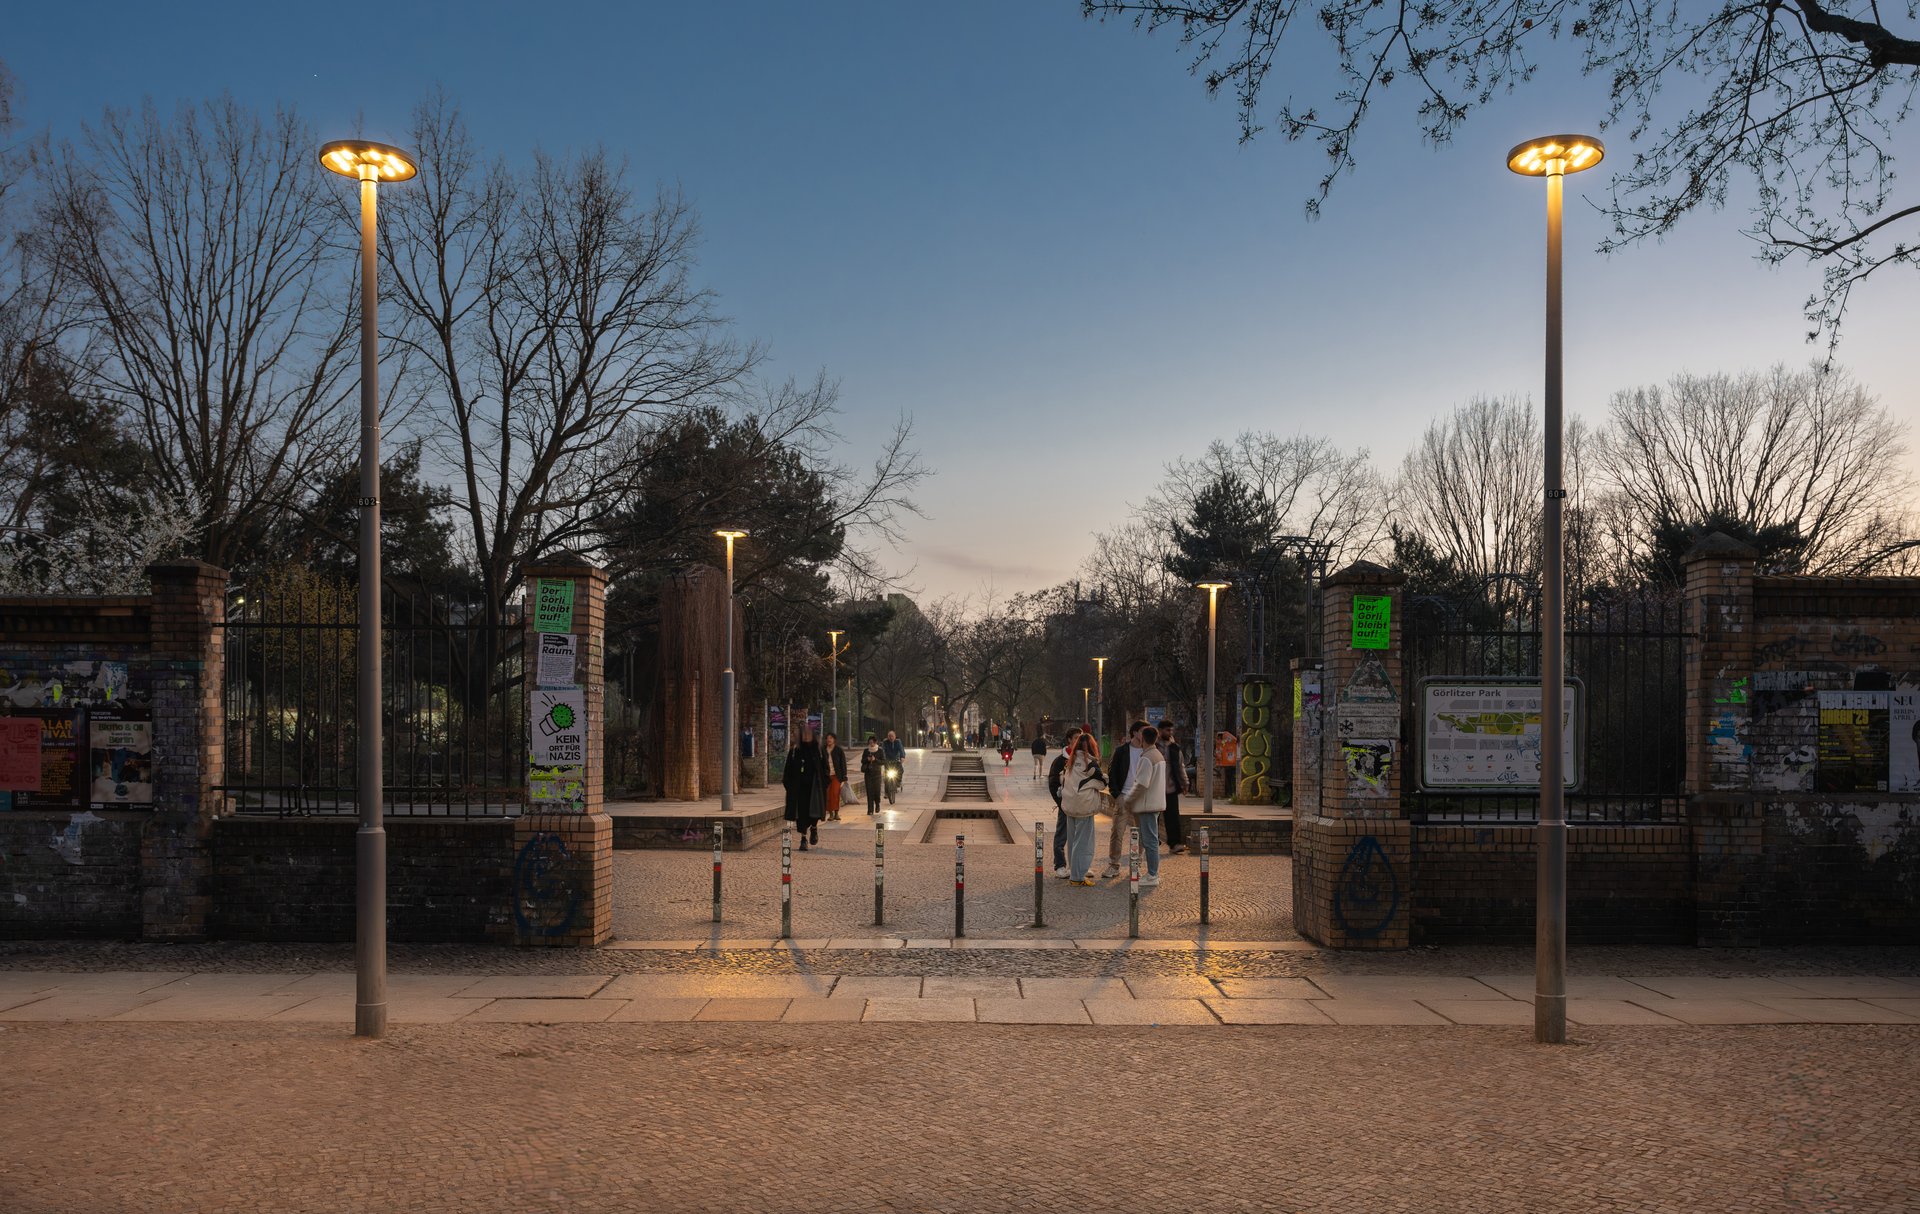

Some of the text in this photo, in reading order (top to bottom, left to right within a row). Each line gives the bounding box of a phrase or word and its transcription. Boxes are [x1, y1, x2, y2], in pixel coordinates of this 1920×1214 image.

[541, 595, 565, 604] Görli
[540, 604, 570, 613] bleibt
[1358, 603, 1377, 611] Der
[539, 613, 561, 621] auf!
[1357, 621, 1388, 629] bleibt
[1357, 630, 1379, 638] auf!
[541, 646, 575, 656] Raum.
[1432, 688, 1502, 697] Görlitzer Park
[556, 735, 580, 743] KEIN
[550, 752, 581, 760] NAZIS
